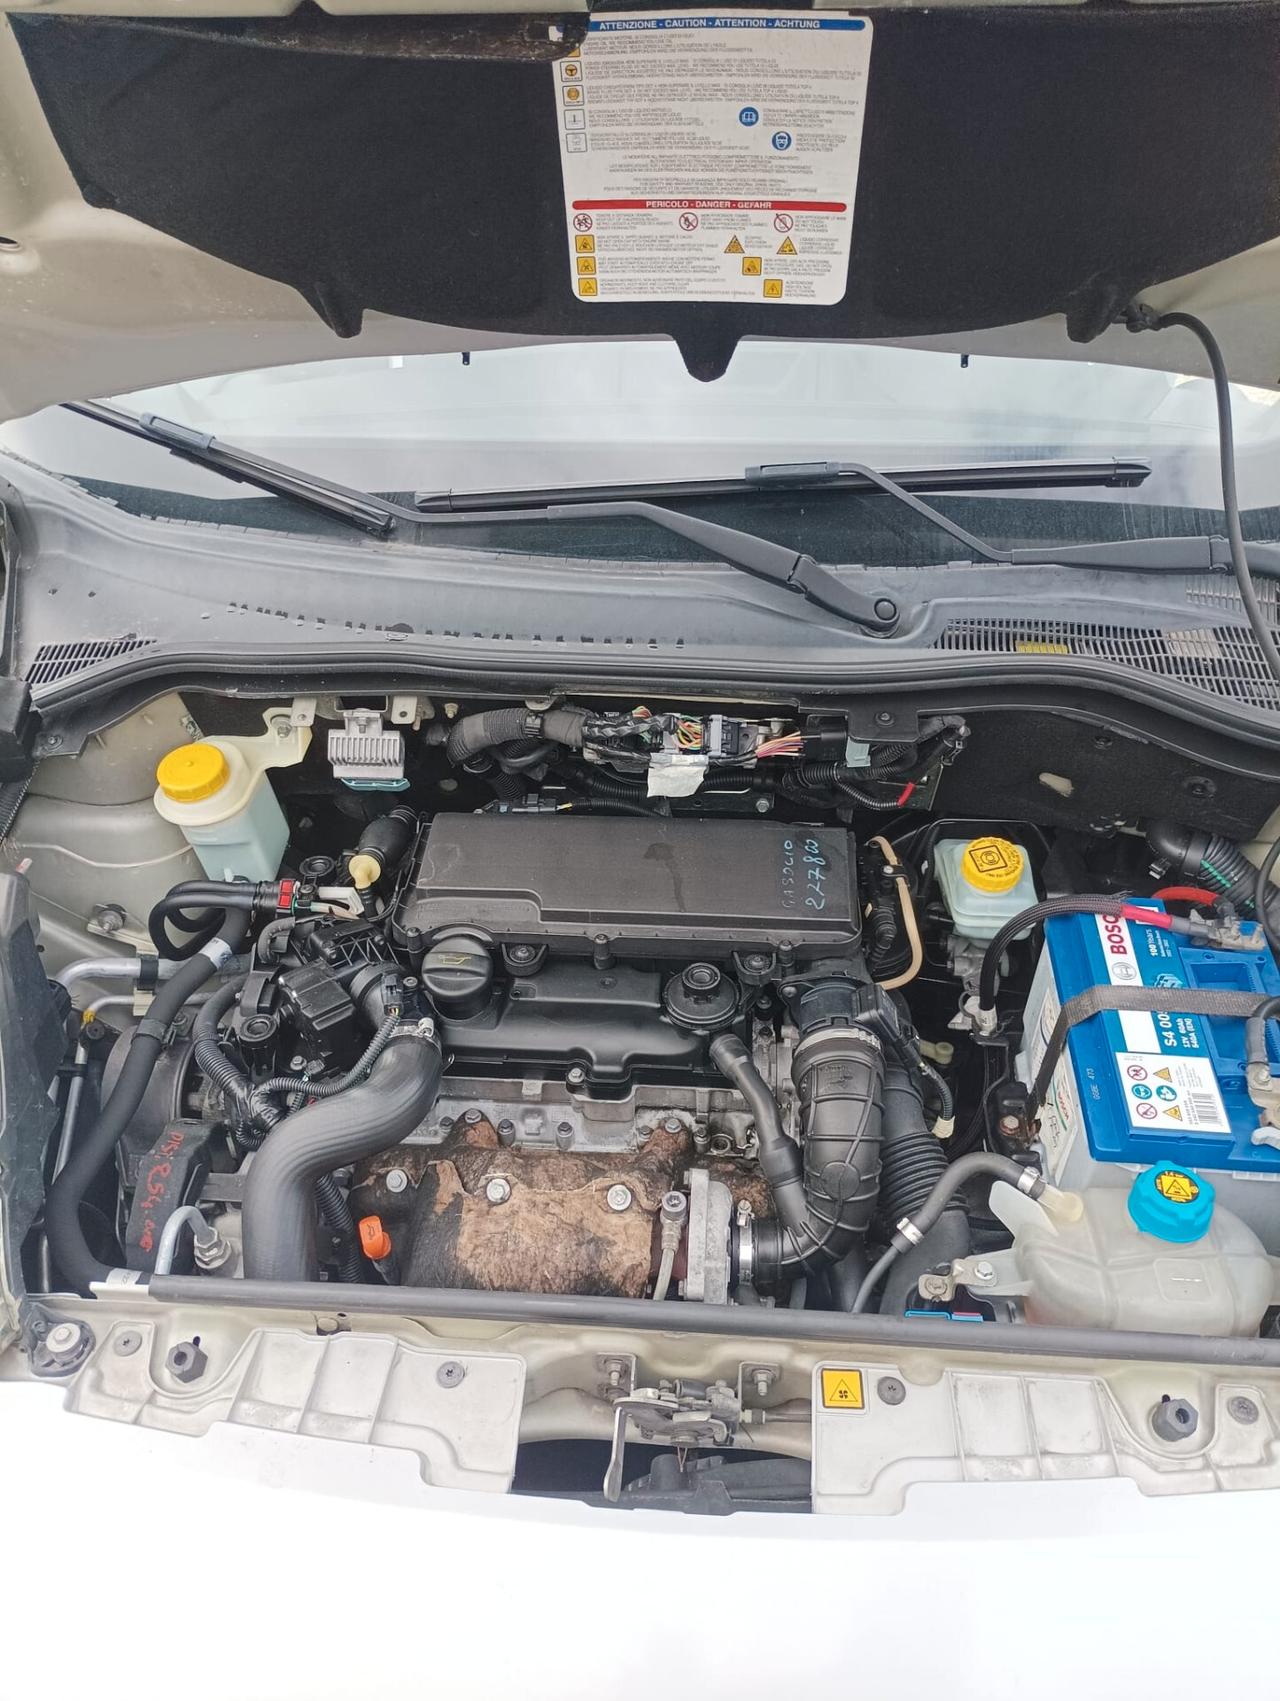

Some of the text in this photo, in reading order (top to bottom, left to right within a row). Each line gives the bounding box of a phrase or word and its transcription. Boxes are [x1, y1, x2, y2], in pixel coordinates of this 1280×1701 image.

[599, 20, 657, 30] ATTENZIONE
[664, 18, 708, 28] CAUTION
[714, 17, 765, 28] ATTENTION
[774, 18, 821, 29] ACHTUNG
[645, 200, 689, 208] PERICOLO
[695, 200, 731, 208] DANGER
[737, 201, 772, 209] GEFAHR
[1102, 913, 1128, 955] BOSC
[1145, 929, 1159, 957] 100 Years
[1162, 1031, 1178, 1047] S4
[1181, 1035, 1191, 1048] 12V
